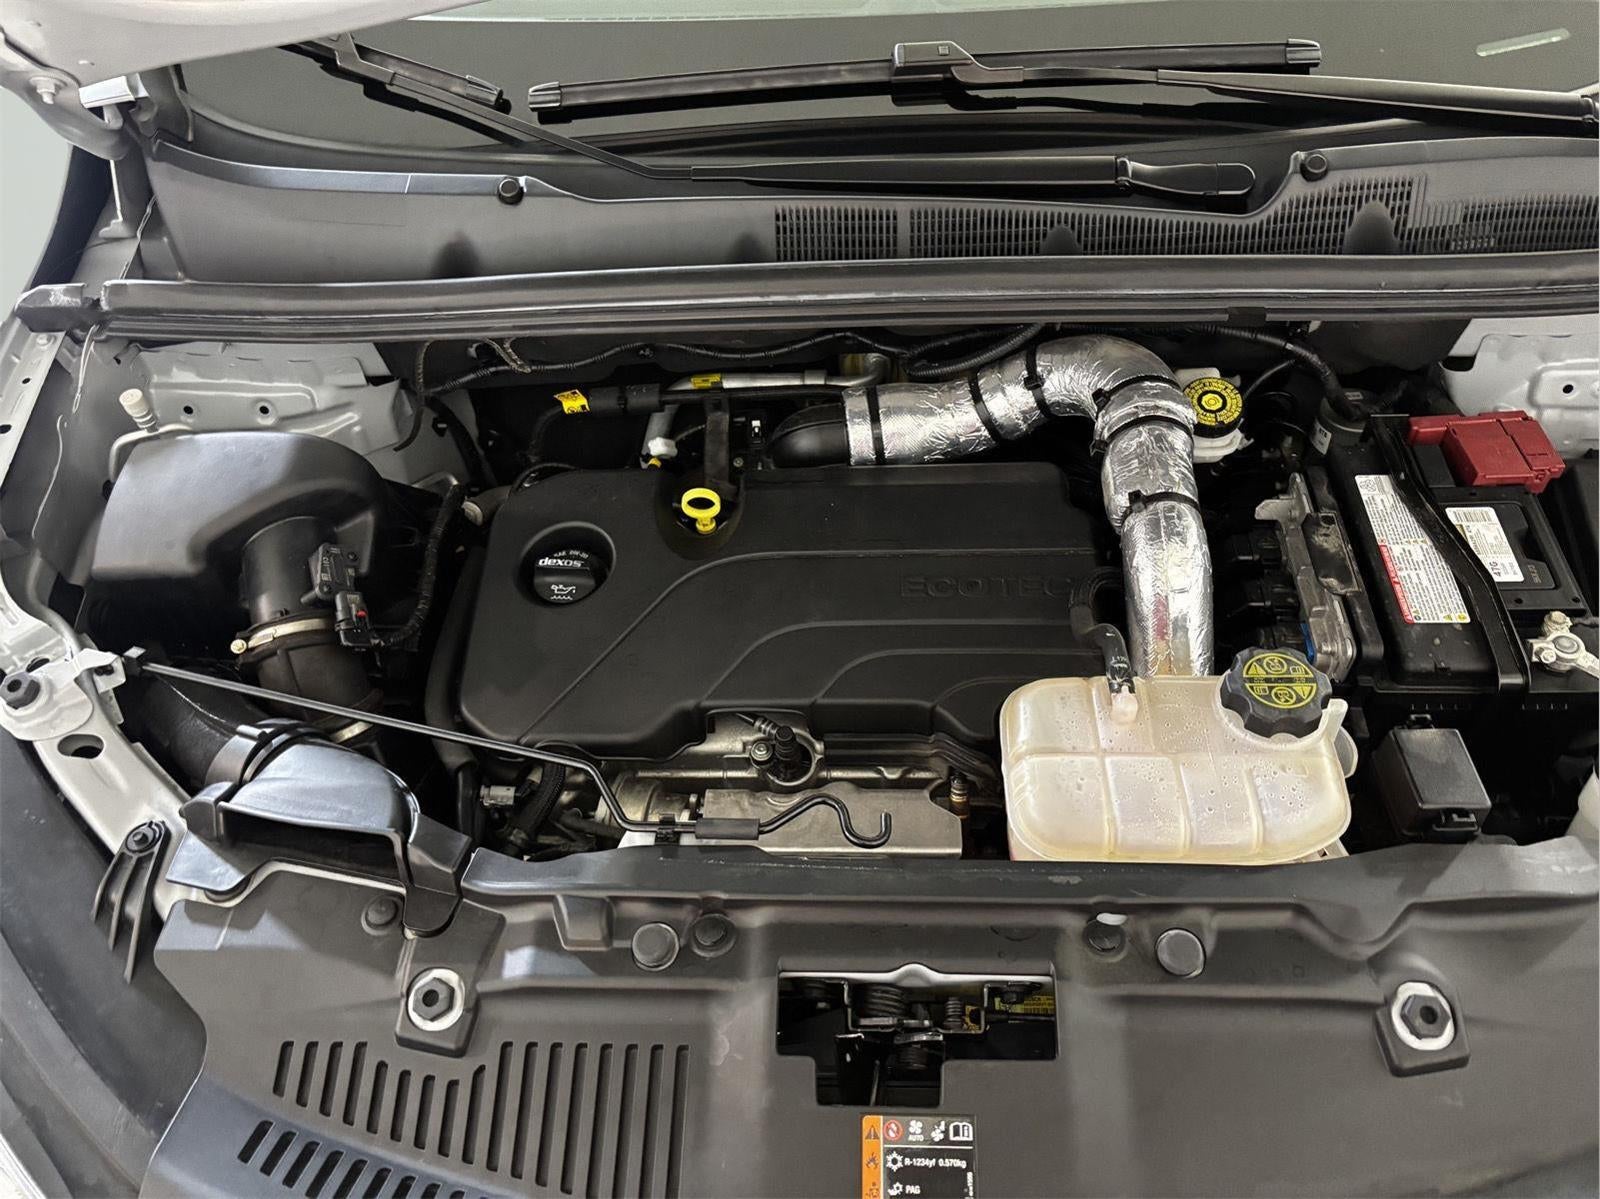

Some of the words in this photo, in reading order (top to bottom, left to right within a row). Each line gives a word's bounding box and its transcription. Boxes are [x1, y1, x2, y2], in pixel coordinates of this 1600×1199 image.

[538, 557, 582, 568] dexos
[901, 576, 1071, 599] ECOTEC
[904, 1157, 936, 1168] R-1234yf
[938, 1158, 967, 1169] 0.570kg
[905, 1184, 921, 1195] PAG
